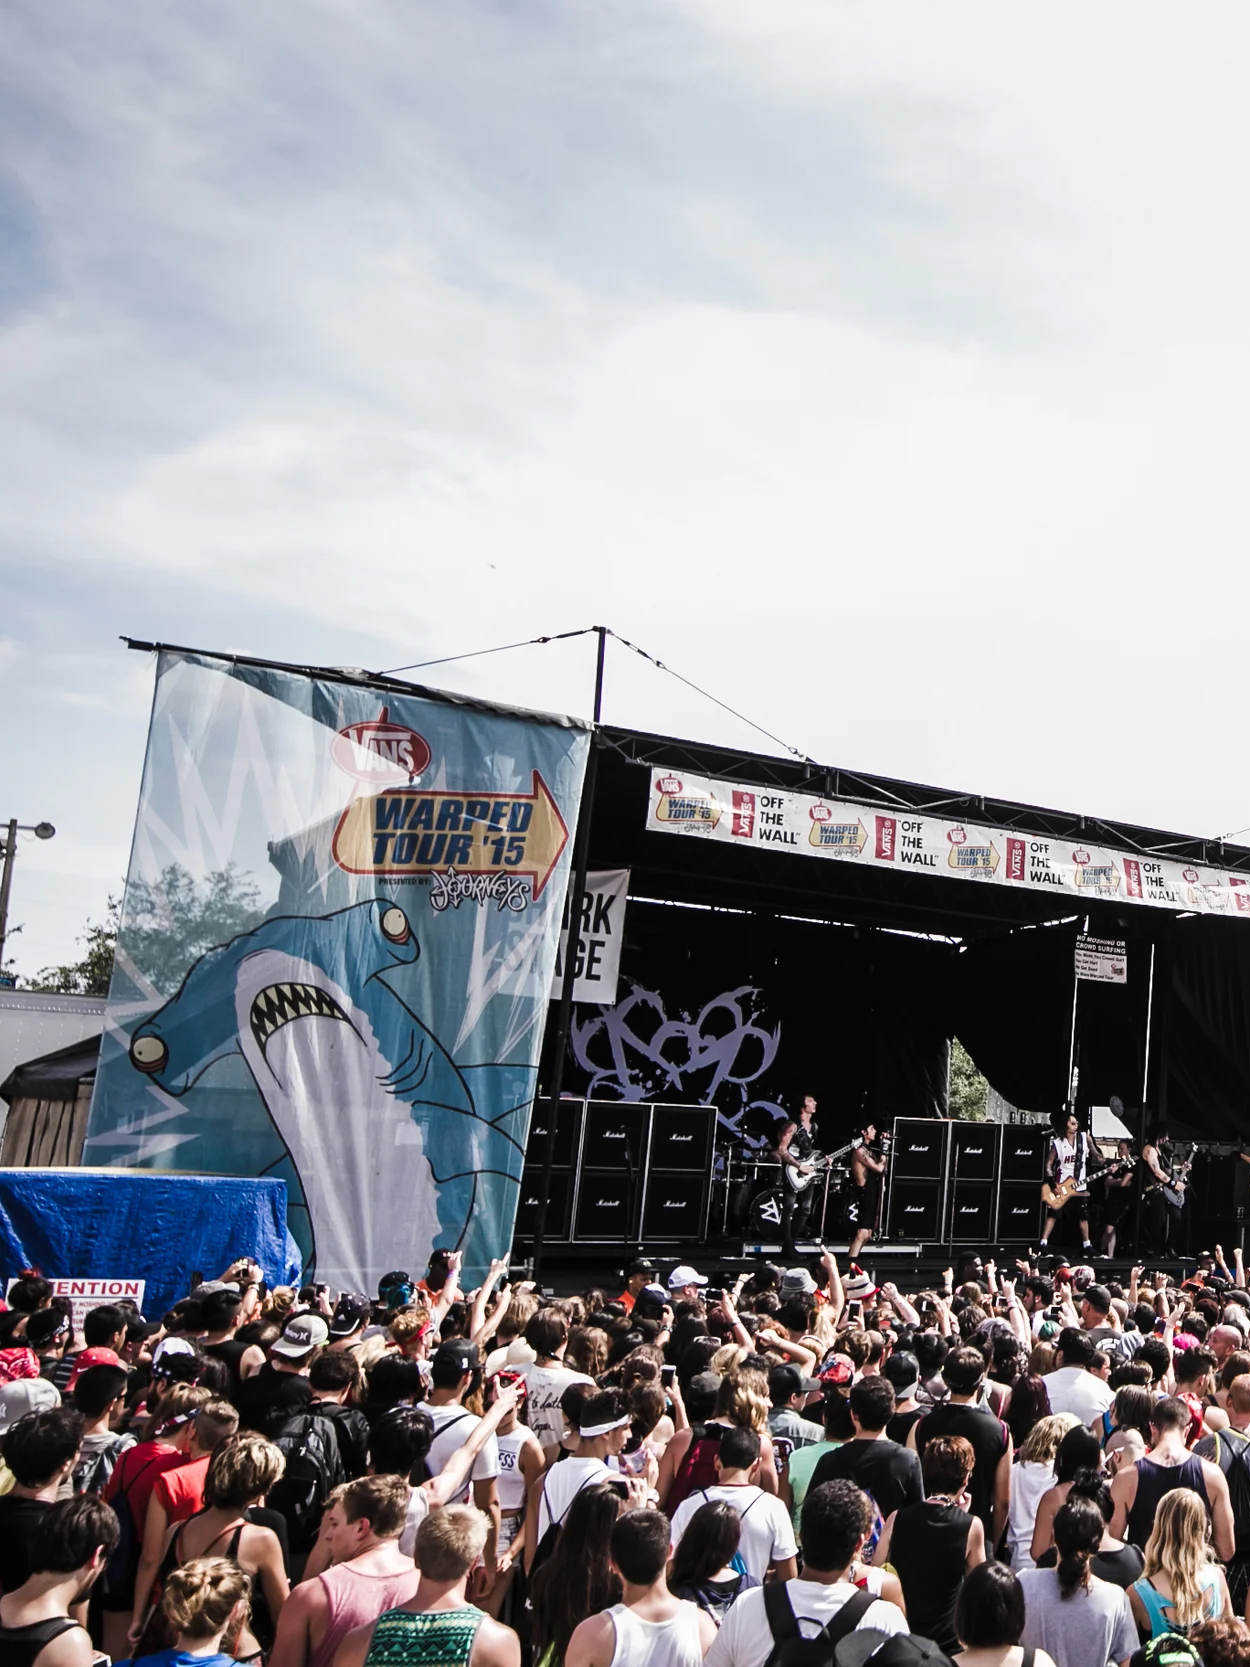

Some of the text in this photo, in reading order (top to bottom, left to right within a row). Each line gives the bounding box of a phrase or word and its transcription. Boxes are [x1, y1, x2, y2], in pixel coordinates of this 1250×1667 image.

[349, 730, 416, 773] VANS
[374, 797, 533, 832] WARPED
[667, 809, 696, 819] TOUR
[739, 802, 752, 833] VANS
[760, 812, 784, 825] THE
[820, 826, 859, 835] WARPED
[820, 835, 845, 844] TOUR
[882, 827, 893, 857] VANS
[901, 836, 923, 849] THE
[372, 831, 528, 866] TOUR '15
[957, 848, 991, 857] WARPED
[957, 857, 979, 866] TOUR
[1012, 848, 1022, 877] VANS
[1030, 856, 1051, 868] THE
[378, 878, 431, 886] PRESENTED BY:
[1145, 875, 1164, 887] THE
[430, 865, 531, 912] JOURNEYS
[1076, 942, 1126, 954] CROWD SURFING
[1064, 1156, 1076, 1164] HE
[53, 1282, 139, 1295] ENTION
